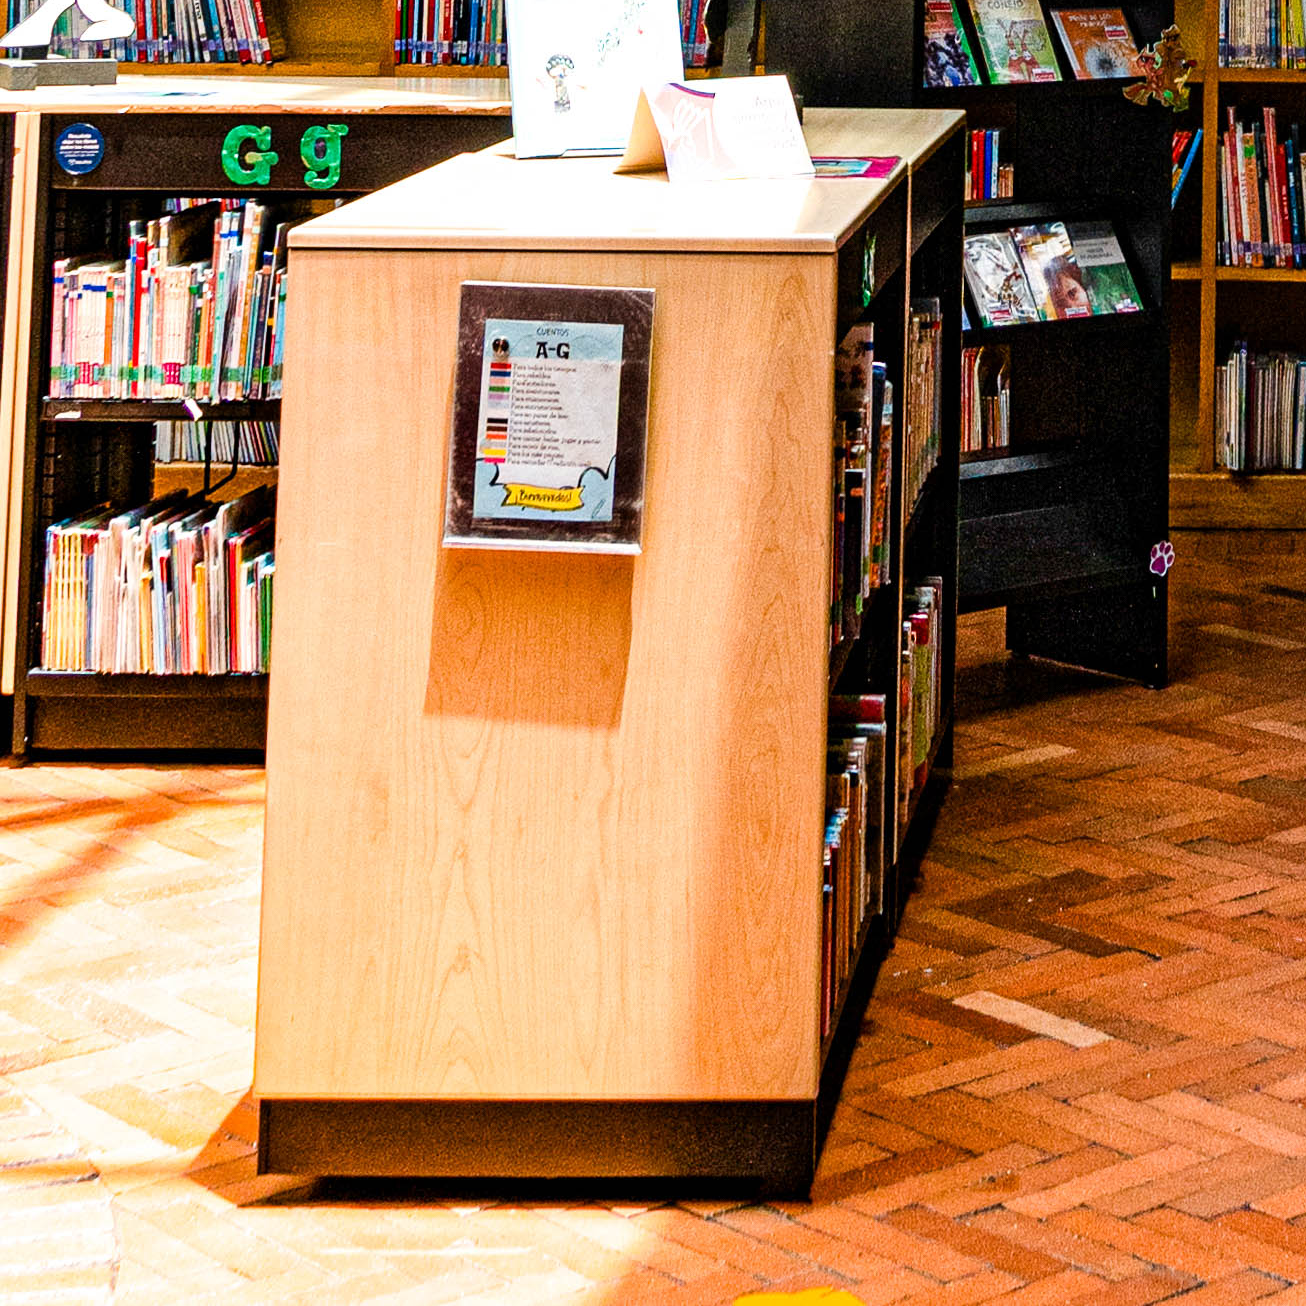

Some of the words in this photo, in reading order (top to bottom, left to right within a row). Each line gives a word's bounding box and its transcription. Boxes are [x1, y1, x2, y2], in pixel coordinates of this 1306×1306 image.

[221, 125, 279, 185] G
[300, 124, 349, 189] g
[536, 327, 570, 337] CUENTOS
[536, 341, 570, 360] A-G
